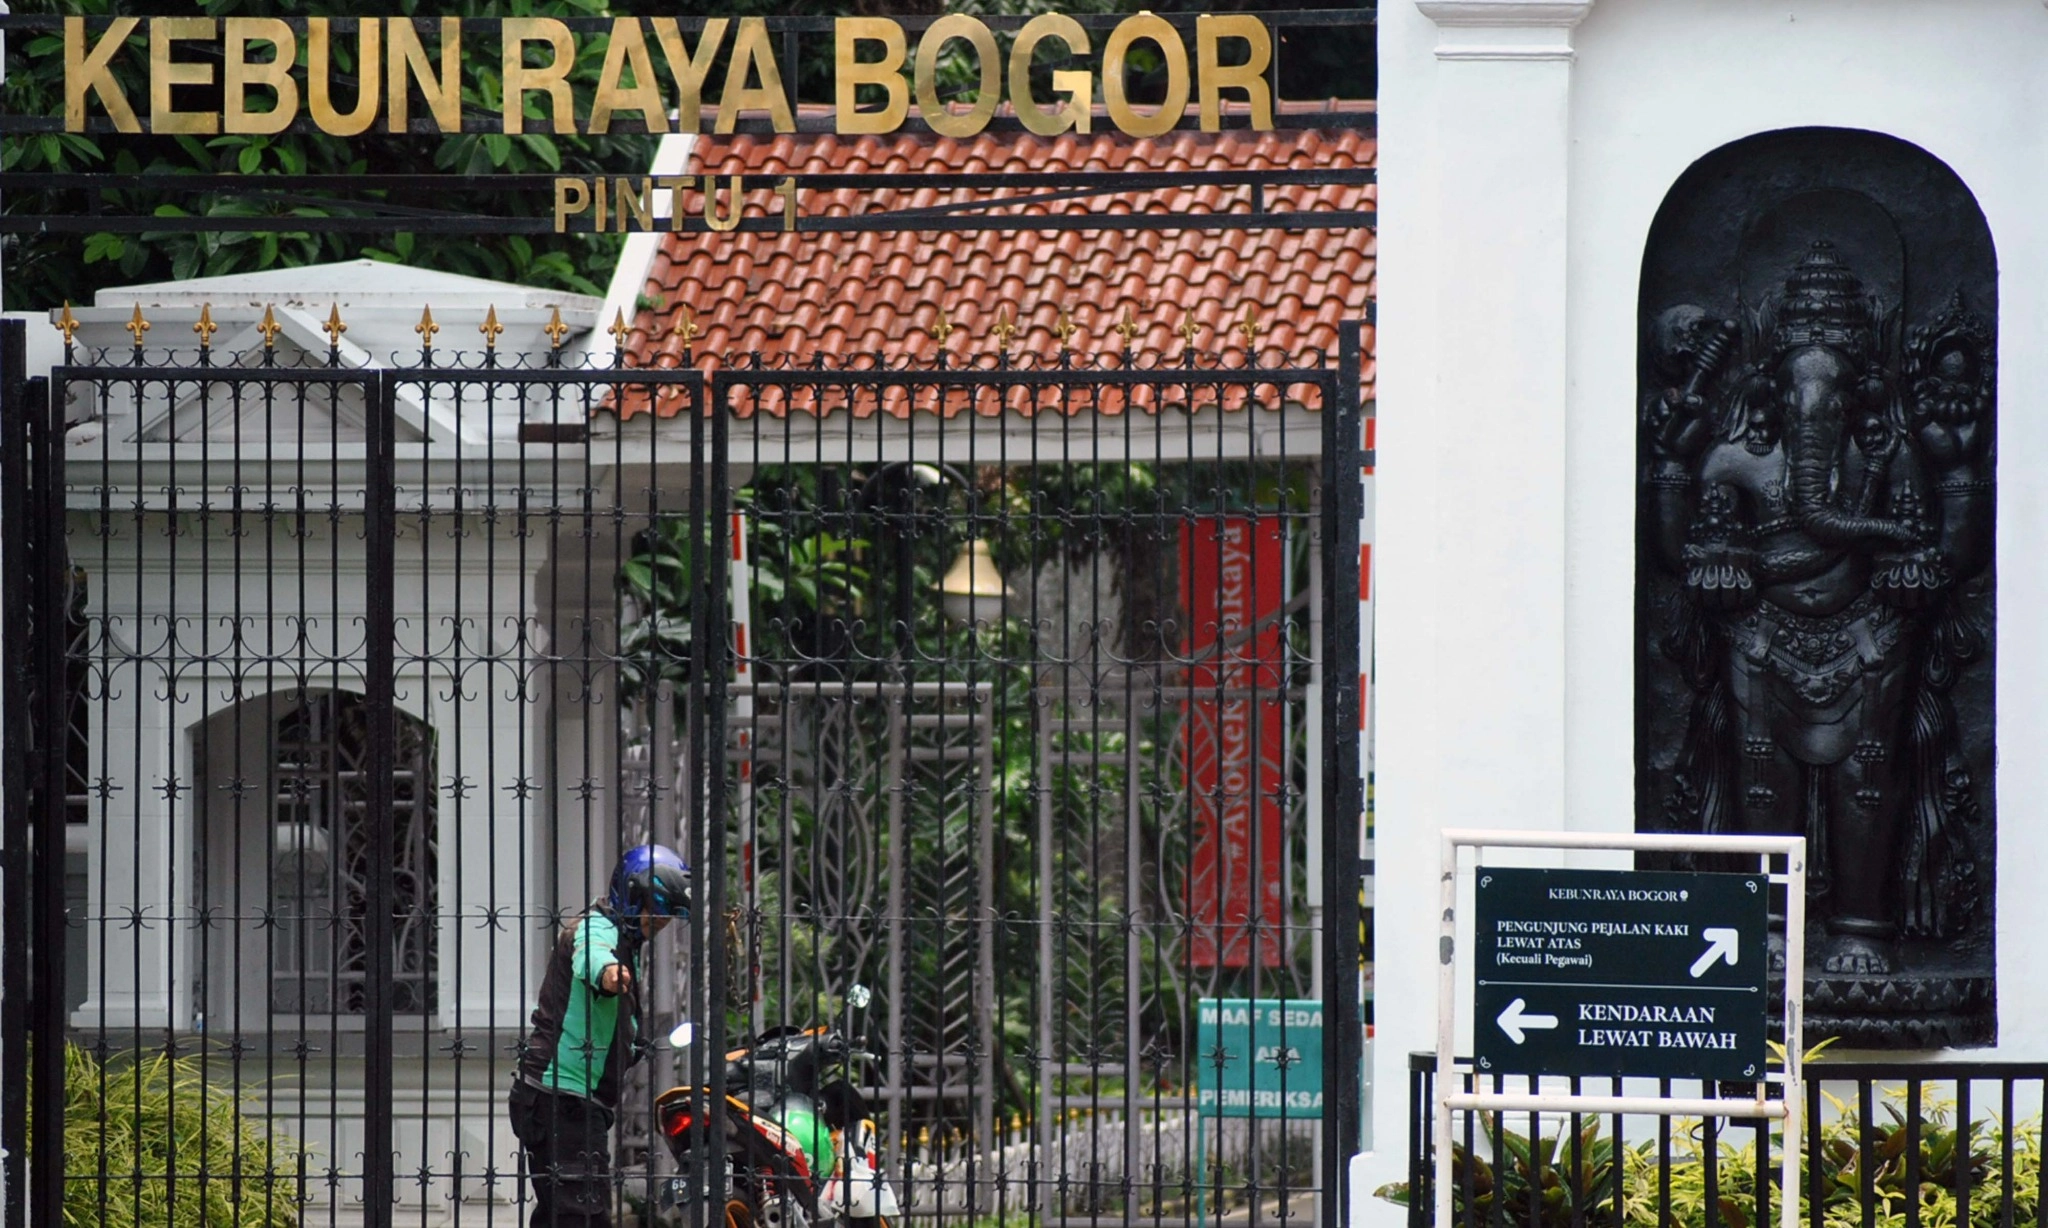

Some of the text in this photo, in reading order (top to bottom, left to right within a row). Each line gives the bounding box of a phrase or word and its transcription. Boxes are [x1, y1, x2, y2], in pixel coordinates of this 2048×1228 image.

[64, 12, 1274, 138] KEBUN RAYA BOGOR
[554, 175, 796, 232] PINTU 1
[1628, 889, 1679, 902] BOGOR
[1497, 921, 1689, 937] PENGUNJUNG PEJALAN KAKI
[1497, 937, 1582, 949] LEWAT ATAS
[1496, 952, 1593, 968] (Kecuali Pegawai)
[1202, 1008, 1262, 1025] MAAF
[1578, 1004, 1716, 1023] KENDARAAN
[1578, 1028, 1738, 1049] LEWAT BAWAH
